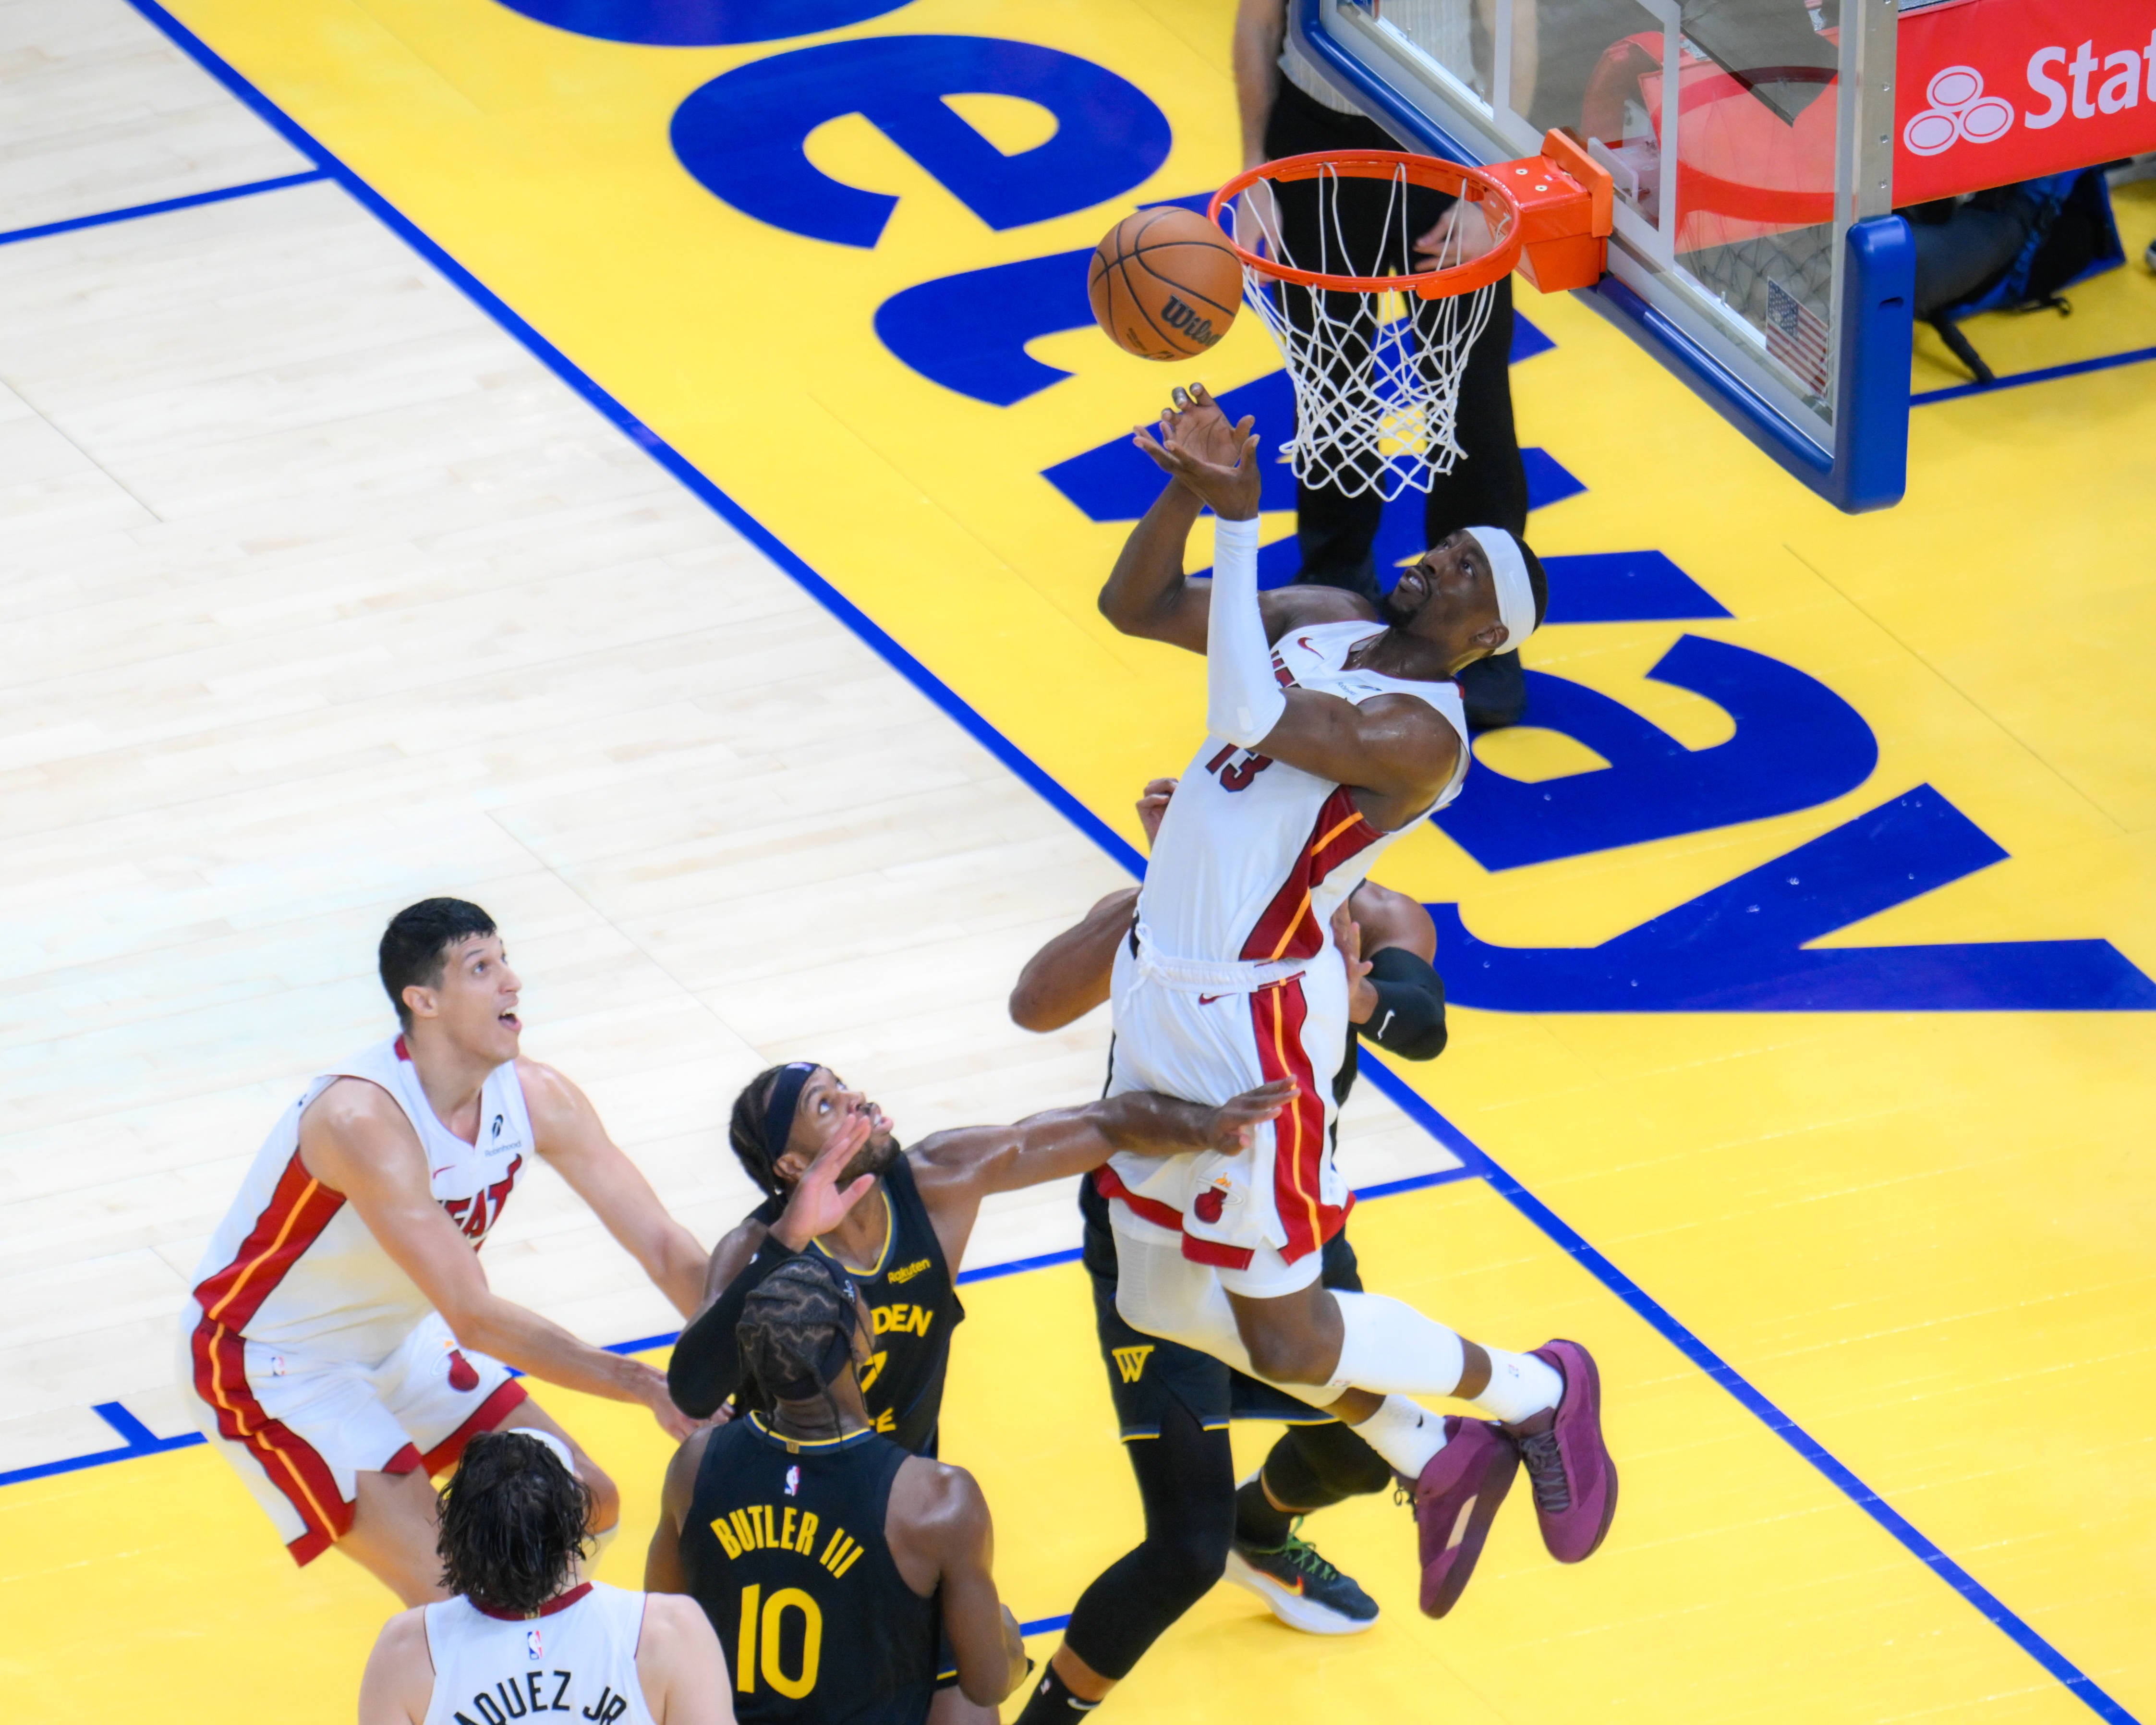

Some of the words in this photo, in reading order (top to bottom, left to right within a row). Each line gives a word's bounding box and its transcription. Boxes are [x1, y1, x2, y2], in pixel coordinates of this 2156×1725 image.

[496, 0, 2156, 1012] etway
[437, 1153, 522, 1240] EAT
[887, 1258, 931, 1284] Rakuten
[871, 1303, 933, 1337] DEN
[710, 1505, 819, 1560] BUTLER
[819, 1528, 864, 1579] III
[737, 1583, 822, 1700] 10
